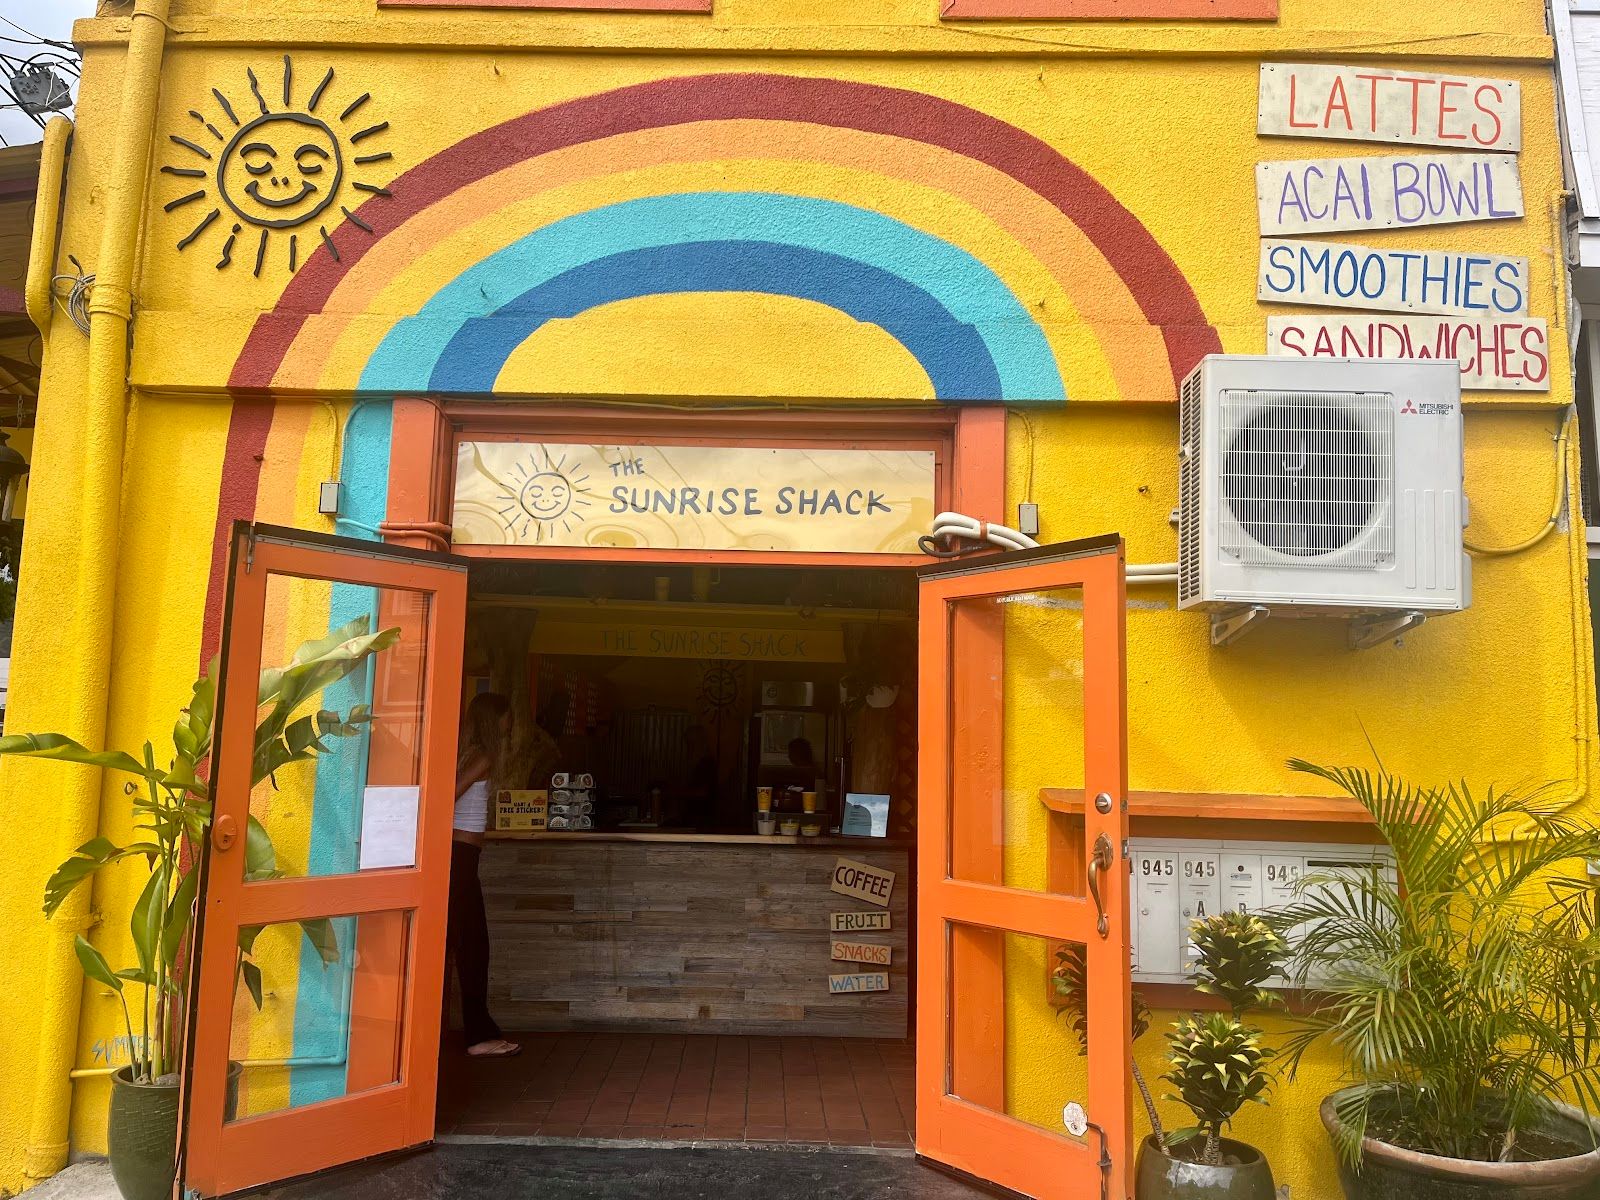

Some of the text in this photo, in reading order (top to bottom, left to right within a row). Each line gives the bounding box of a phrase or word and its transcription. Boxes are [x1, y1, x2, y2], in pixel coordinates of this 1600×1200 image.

[1288, 74, 1503, 146] LATTES
[1278, 162, 1517, 225] ACAI BOWL
[1265, 246, 1523, 313] SMOOTHIES
[609, 457, 645, 478] THE
[608, 485, 892, 516] SUNRISE SHACK
[648, 629, 732, 656] SUNRISE
[737, 632, 808, 657] SHACK
[1142, 859, 1174, 876] 945
[1184, 861, 1215, 878] 945
[835, 866, 891, 898] COFFEE
[1196, 900, 1206, 917] A
[835, 913, 888, 930] FRUIT
[833, 942, 888, 964] SNACKS
[830, 974, 885, 991] WATER
